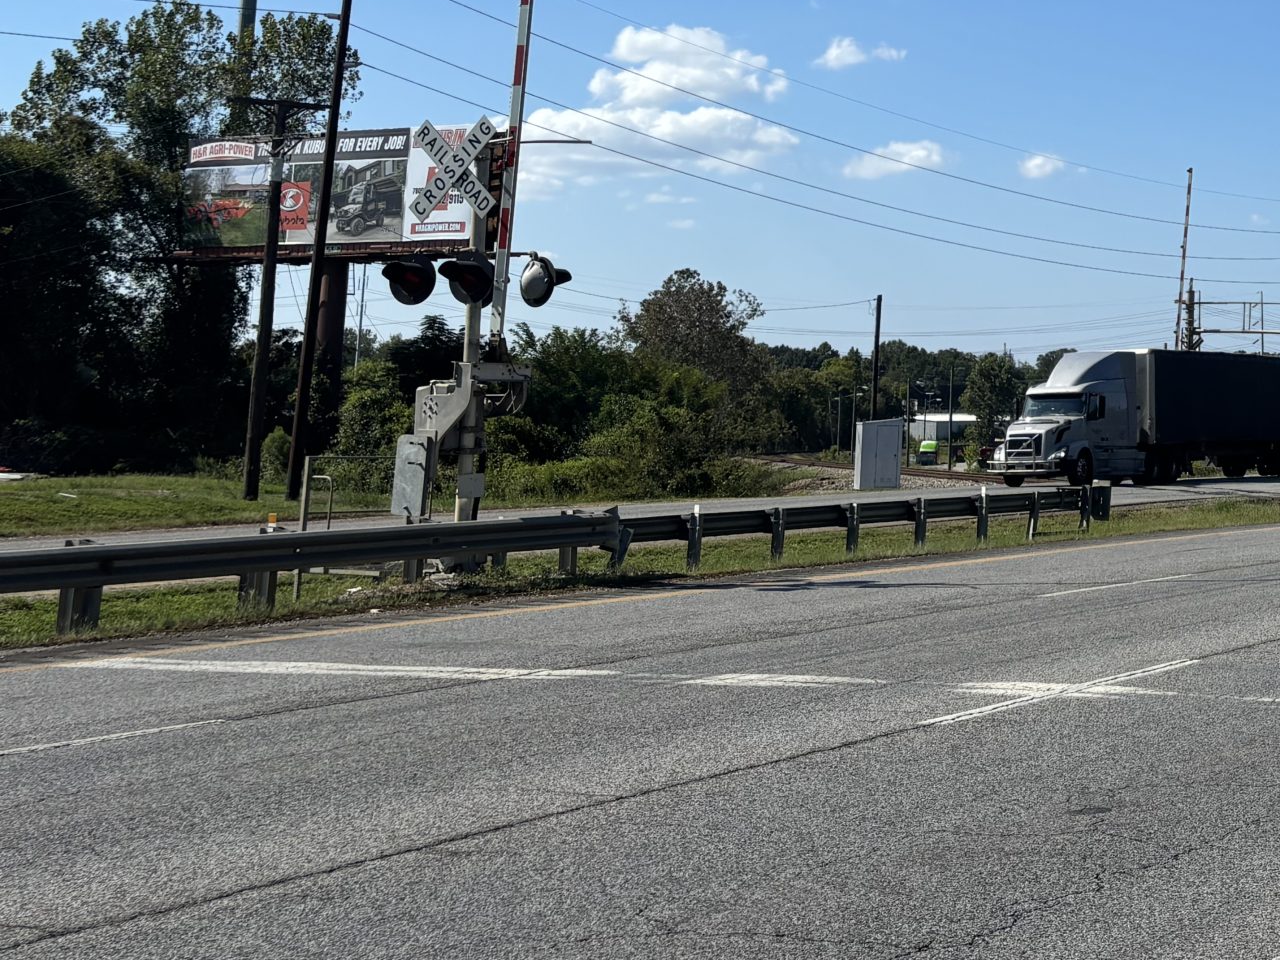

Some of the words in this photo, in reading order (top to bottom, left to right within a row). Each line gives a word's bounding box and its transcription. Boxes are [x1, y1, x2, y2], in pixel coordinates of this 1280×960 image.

[192, 146, 208, 160] H&R
[209, 143, 254, 157] AGRI-POWER
[303, 140, 326, 154] KUBO
[337, 138, 355, 152] FOR
[355, 136, 384, 151] EVERY
[384, 135, 407, 150] JOB!
[415, 122, 491, 215] CROSSING
[418, 126, 448, 165] RAIL
[455, 171, 490, 211] ROAD
[280, 216, 305, 226] ubota
